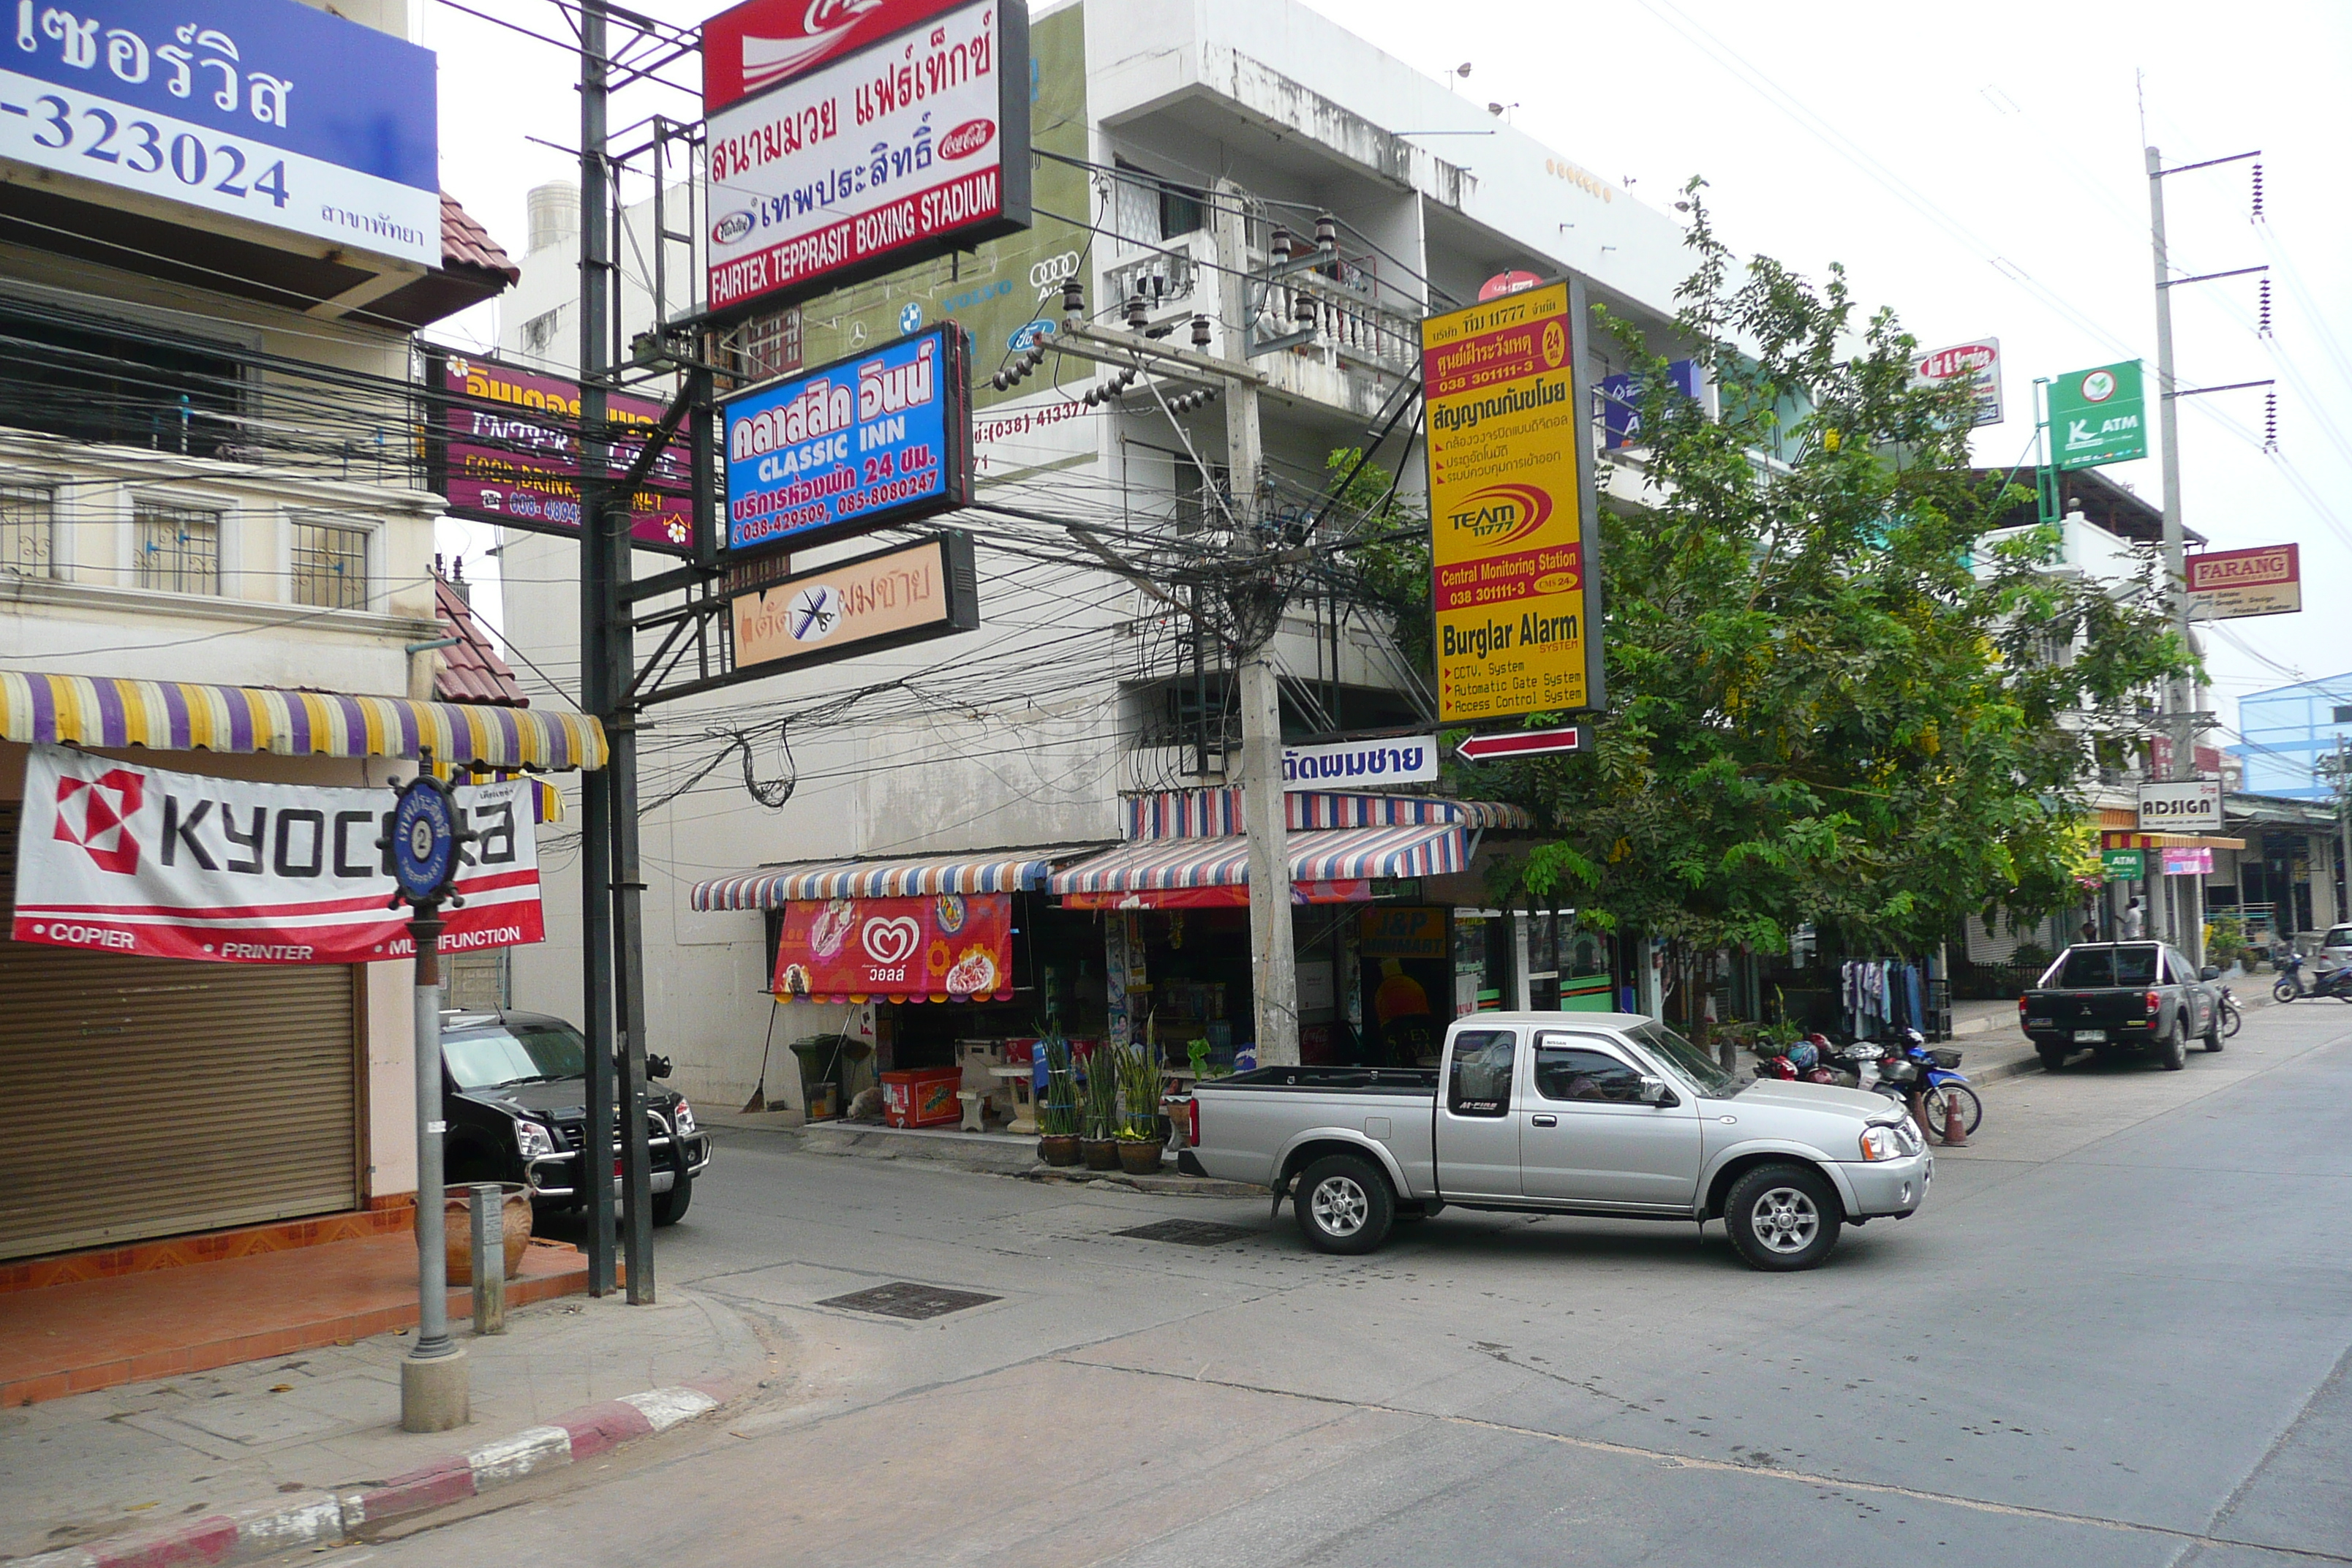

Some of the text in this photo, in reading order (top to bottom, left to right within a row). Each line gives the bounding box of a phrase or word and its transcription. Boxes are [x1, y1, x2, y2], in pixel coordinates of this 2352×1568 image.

[711, 10, 992, 182] สนามมวย แฟร์เท็กซ์
[761, 110, 932, 227] เทพประสิทธิ์
[321, 205, 424, 246] สาขาพัทยา
[712, 171, 997, 304] FAIRTEX TEPPRASIT BOXING STADIUM
[942, 279, 1012, 313] VOLVO
[1463, 313, 1485, 333] ทีม
[1489, 304, 1525, 326] 11777
[1546, 329, 1559, 350] 24
[1439, 361, 1534, 393] 038 301111-3
[732, 377, 853, 463] คลาสสิค
[858, 338, 935, 423] อินน์
[1433, 377, 1566, 431] สัญญาณกันขโมย
[2100, 415, 2138, 433] ATM
[758, 415, 905, 483] CLASSIC INN
[864, 452, 894, 485] 24
[900, 443, 937, 474] ชม.
[743, 470, 938, 542] 038-429509, 085-8080247
[1447, 505, 1515, 530] TEAM
[1472, 521, 1515, 537] 11777
[1441, 550, 1577, 587] Central Monitoring Station
[2198, 557, 2285, 580] FARANG
[1450, 581, 1526, 606] 038 301111-3
[1443, 612, 1578, 660] Burglar Alarm
[1539, 640, 1578, 654] SYSTEM
[1453, 660, 1524, 680] CCTV. System
[1454, 673, 1581, 697] Automatic Gate System
[1455, 690, 1582, 713] Access Control System
[1282, 746, 1423, 780] ตัดผมชาย
[418, 829, 426, 849] 2
[2112, 856, 2137, 865] ATM
[1376, 912, 1428, 936] J&P
[50, 921, 521, 960] COPIER PRINTER MUIFUNCTION
